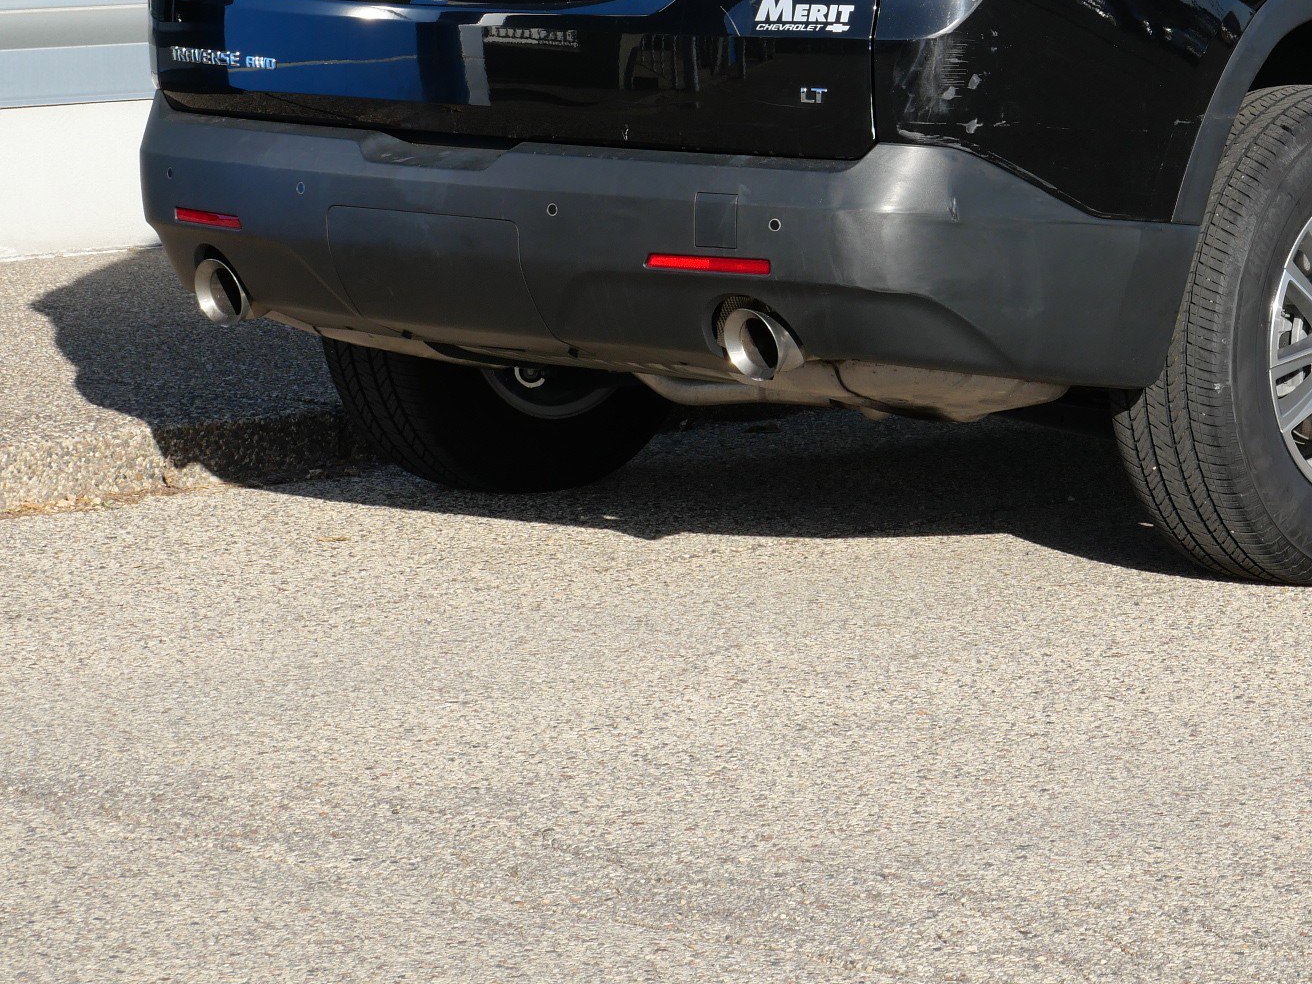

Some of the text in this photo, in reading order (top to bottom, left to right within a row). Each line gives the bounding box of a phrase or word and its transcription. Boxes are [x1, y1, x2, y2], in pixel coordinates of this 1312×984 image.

[756, 23, 824, 32] CHEVROLET
[170, 45, 276, 70] TRAVERSE AWD
[800, 87, 828, 103] LT
